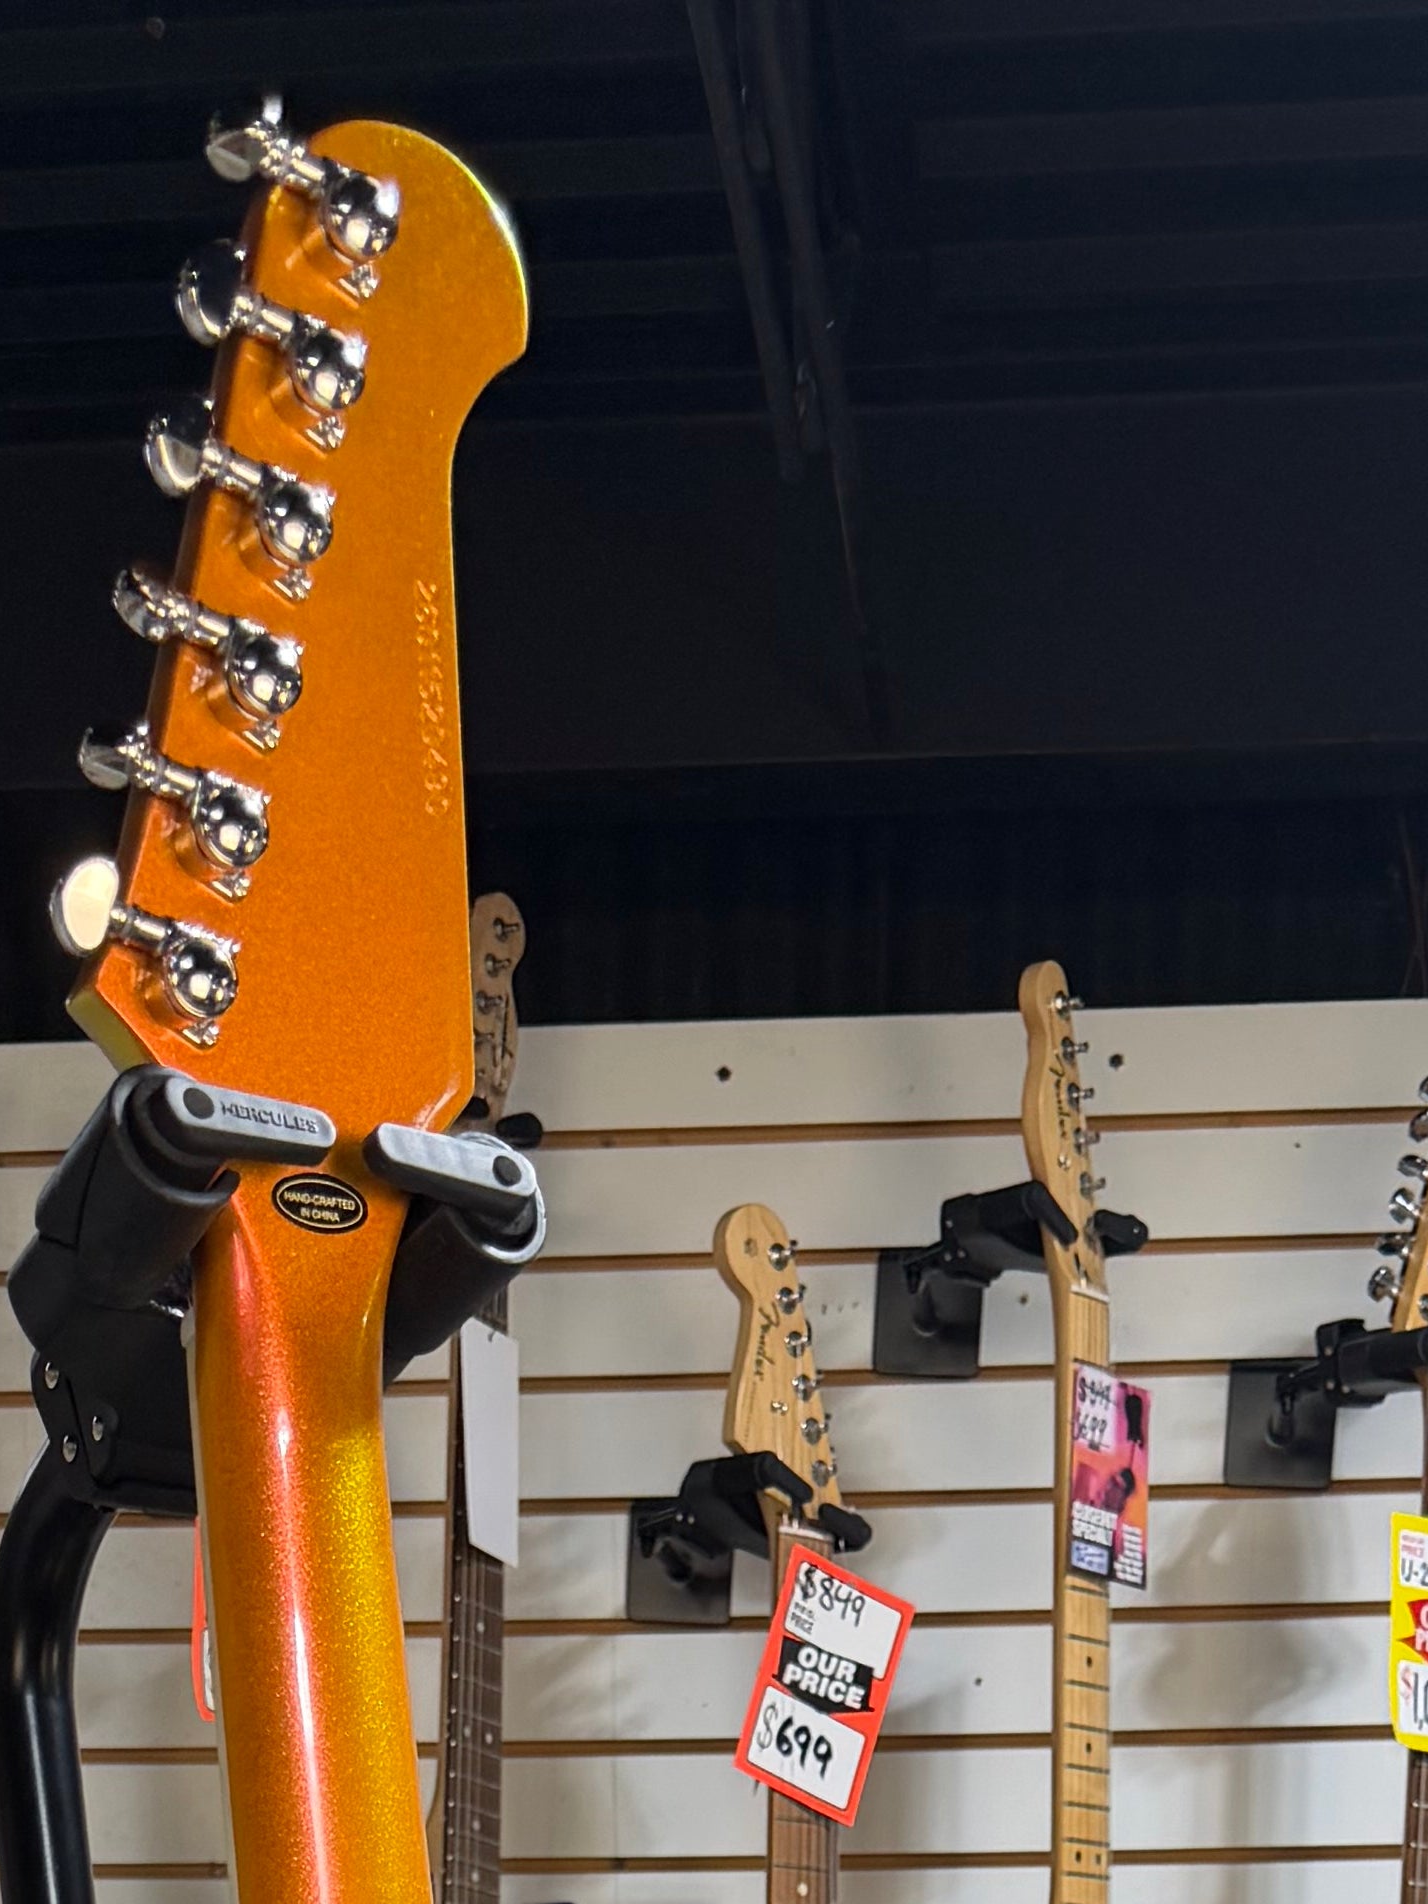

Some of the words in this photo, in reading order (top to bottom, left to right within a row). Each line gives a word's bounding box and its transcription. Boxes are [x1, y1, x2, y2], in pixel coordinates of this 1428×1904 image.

[220, 1100, 318, 1134] HERCULES
[283, 1190, 356, 1211] HAND-CRAFTED
[300, 1207, 311, 1219] IN
[311, 1208, 341, 1222] CHINA
[795, 1563, 866, 1628] $849
[797, 1645, 858, 1684] OUR
[782, 1665, 866, 1710] PRICE
[756, 1701, 833, 1780] $699
